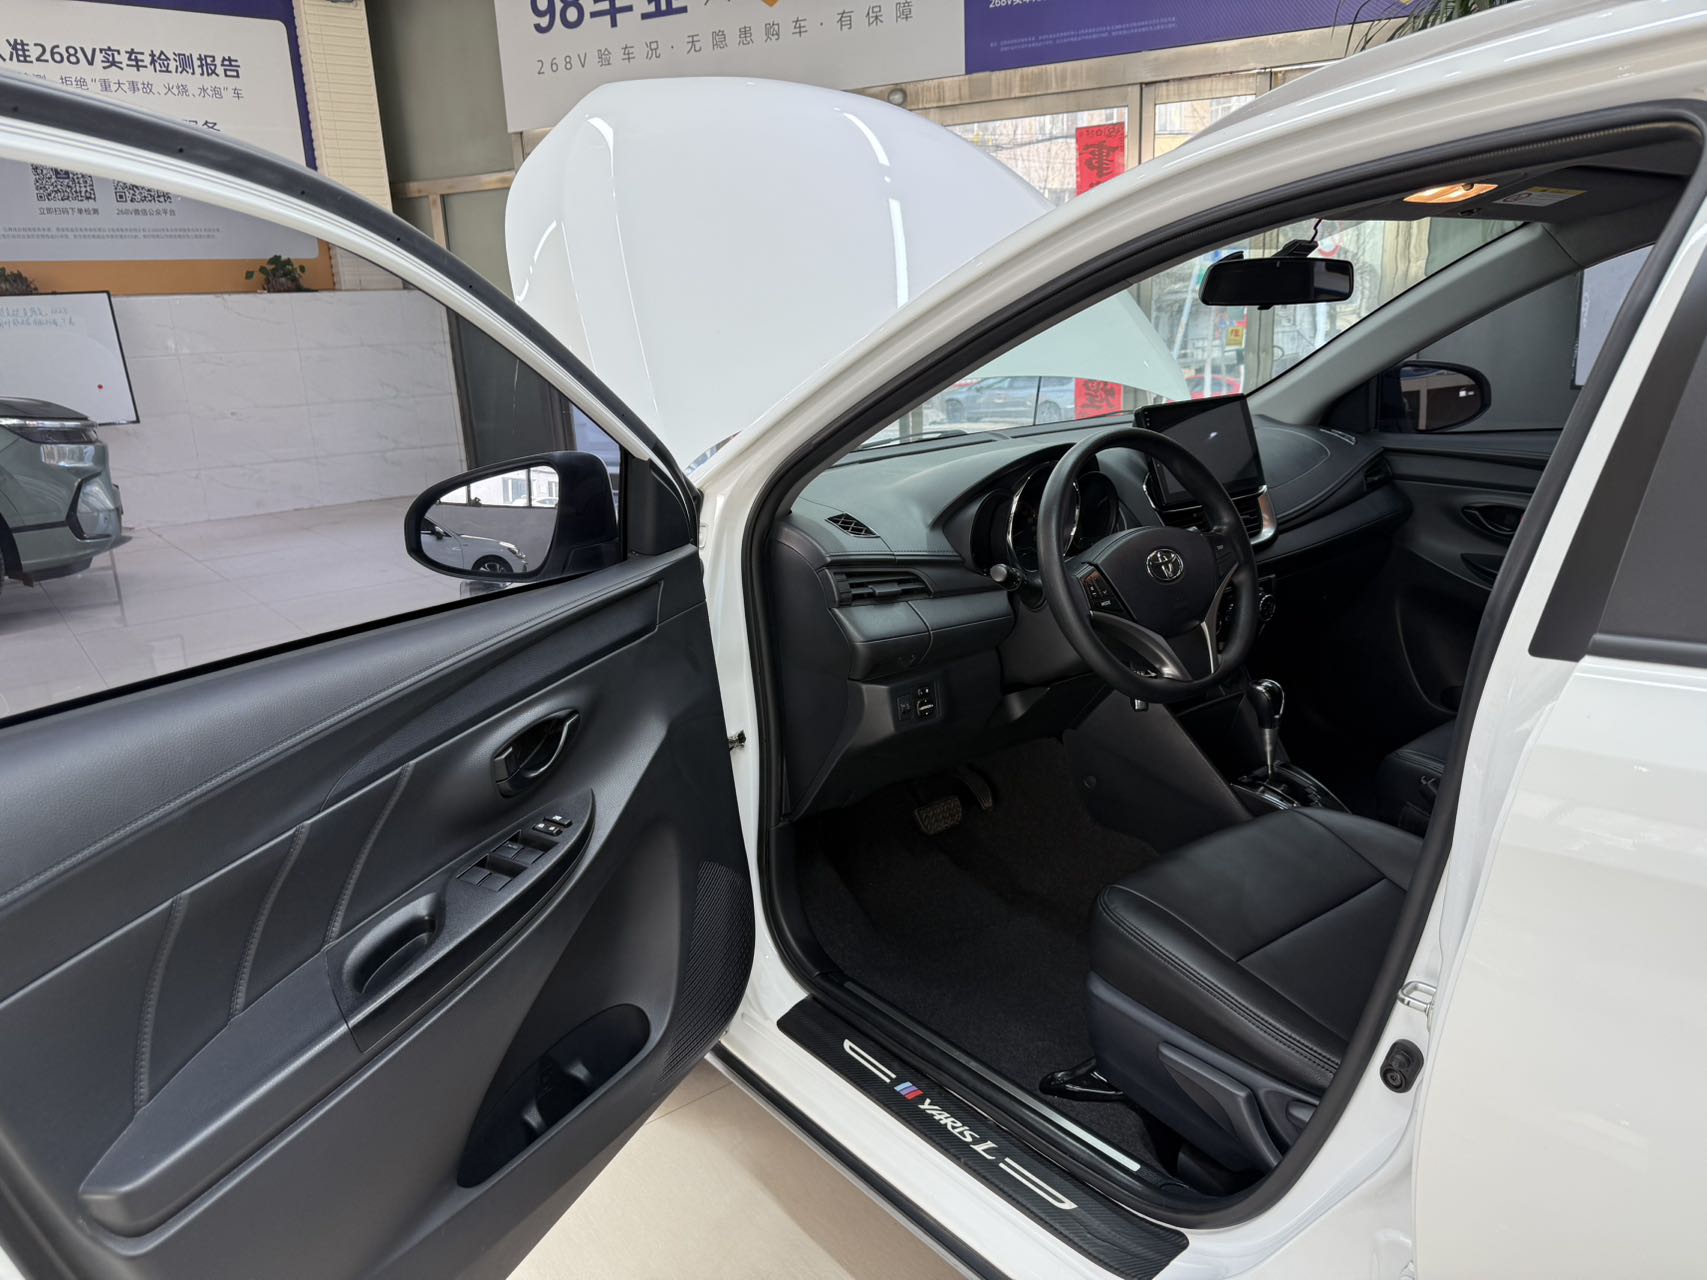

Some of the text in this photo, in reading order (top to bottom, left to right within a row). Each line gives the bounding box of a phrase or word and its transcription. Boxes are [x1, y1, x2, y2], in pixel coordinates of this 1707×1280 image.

[0, 38, 241, 79] 准268V实车检测报告
[918, 1098, 980, 1142] YARIS
